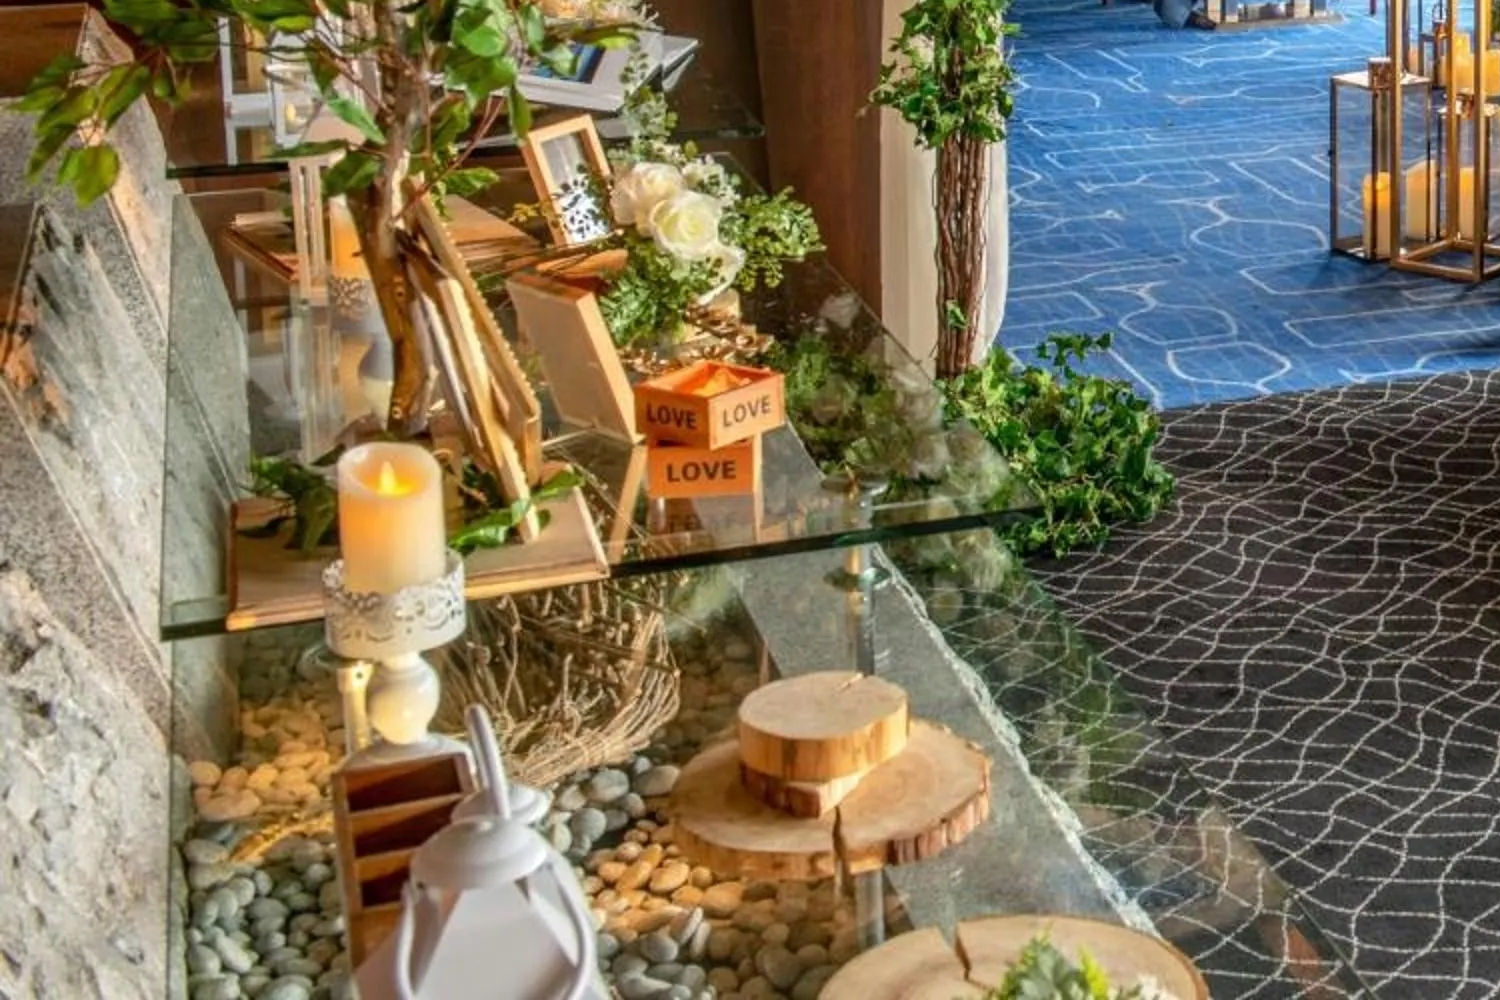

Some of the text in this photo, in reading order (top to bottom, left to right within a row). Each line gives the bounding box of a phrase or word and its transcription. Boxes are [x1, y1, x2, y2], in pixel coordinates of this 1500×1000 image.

[646, 403, 697, 430] LOVE
[722, 395, 771, 427] LOVE
[666, 460, 737, 483] LOVE
